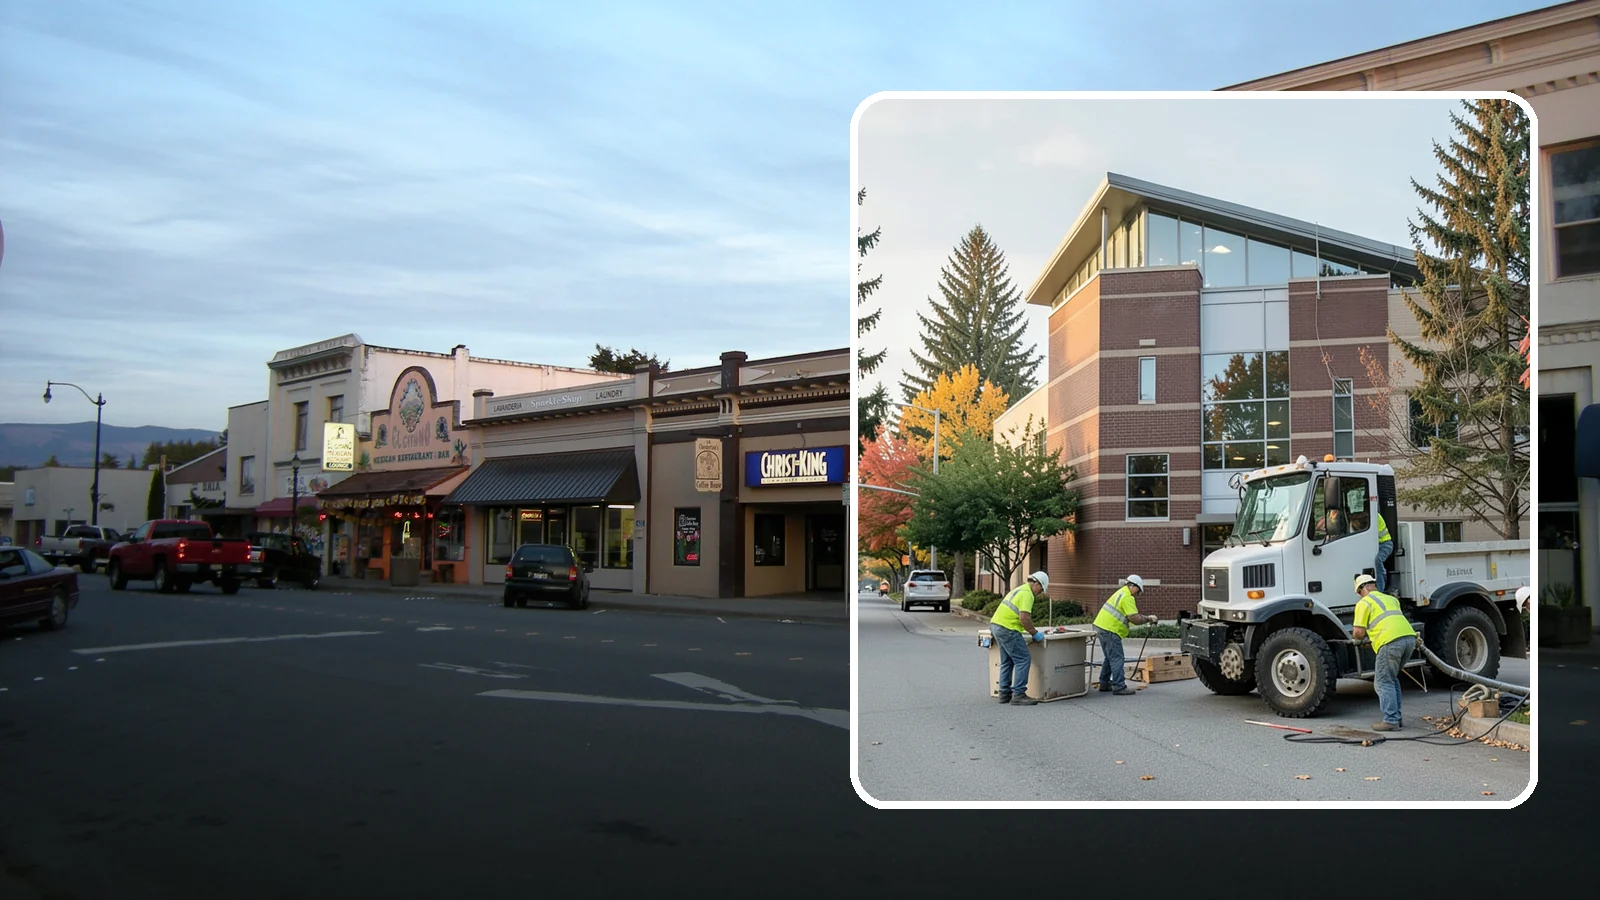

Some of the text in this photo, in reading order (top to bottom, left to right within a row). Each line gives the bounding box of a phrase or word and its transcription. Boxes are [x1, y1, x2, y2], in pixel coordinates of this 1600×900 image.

[595, 388, 624, 400] LAUNDRY
[493, 402, 523, 412] LAVANDERIA
[530, 394, 583, 409] Sparkle Shop
[373, 450, 450, 464] MEXICAN RESTAURANT BAR
[761, 450, 828, 478] CHRIST KING
[710, 481, 722, 489] House
